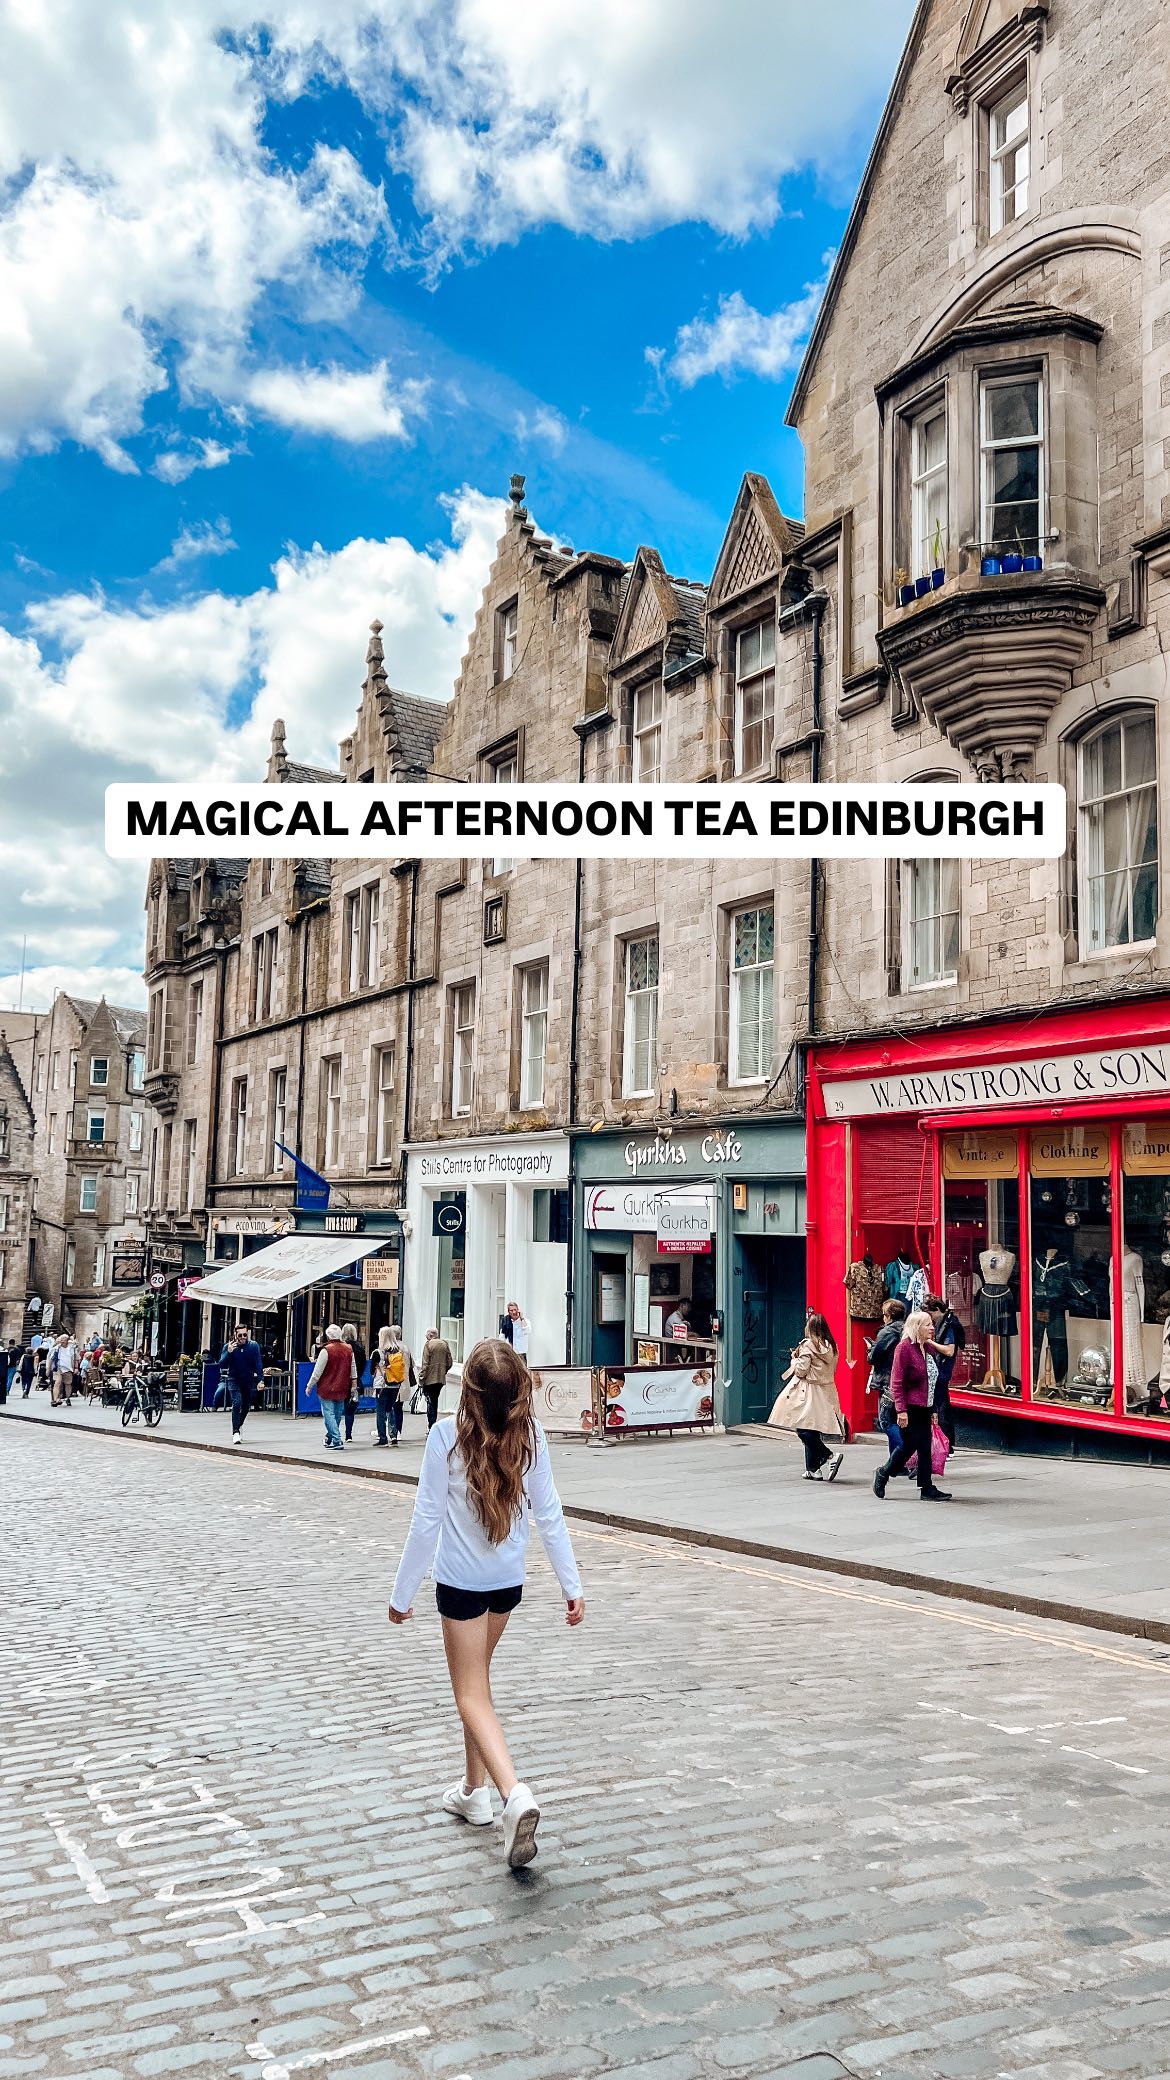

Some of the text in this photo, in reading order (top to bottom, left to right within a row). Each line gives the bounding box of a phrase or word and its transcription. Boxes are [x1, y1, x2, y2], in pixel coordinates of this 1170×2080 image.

[1073, 1059, 1095, 1090] &
[1099, 1050, 1167, 1088] SON
[835, 1101, 845, 1112] 29
[624, 1131, 742, 1176] Gurkha Cafe
[1040, 1143, 1100, 1160] Clothing
[421, 1150, 553, 1176] Stills Centre for Photography
[624, 1193, 670, 1216] Gurkh
[235, 1221, 250, 1231] ecco
[660, 1214, 708, 1230] Gurkha
[151, 1276, 164, 1284] 20
